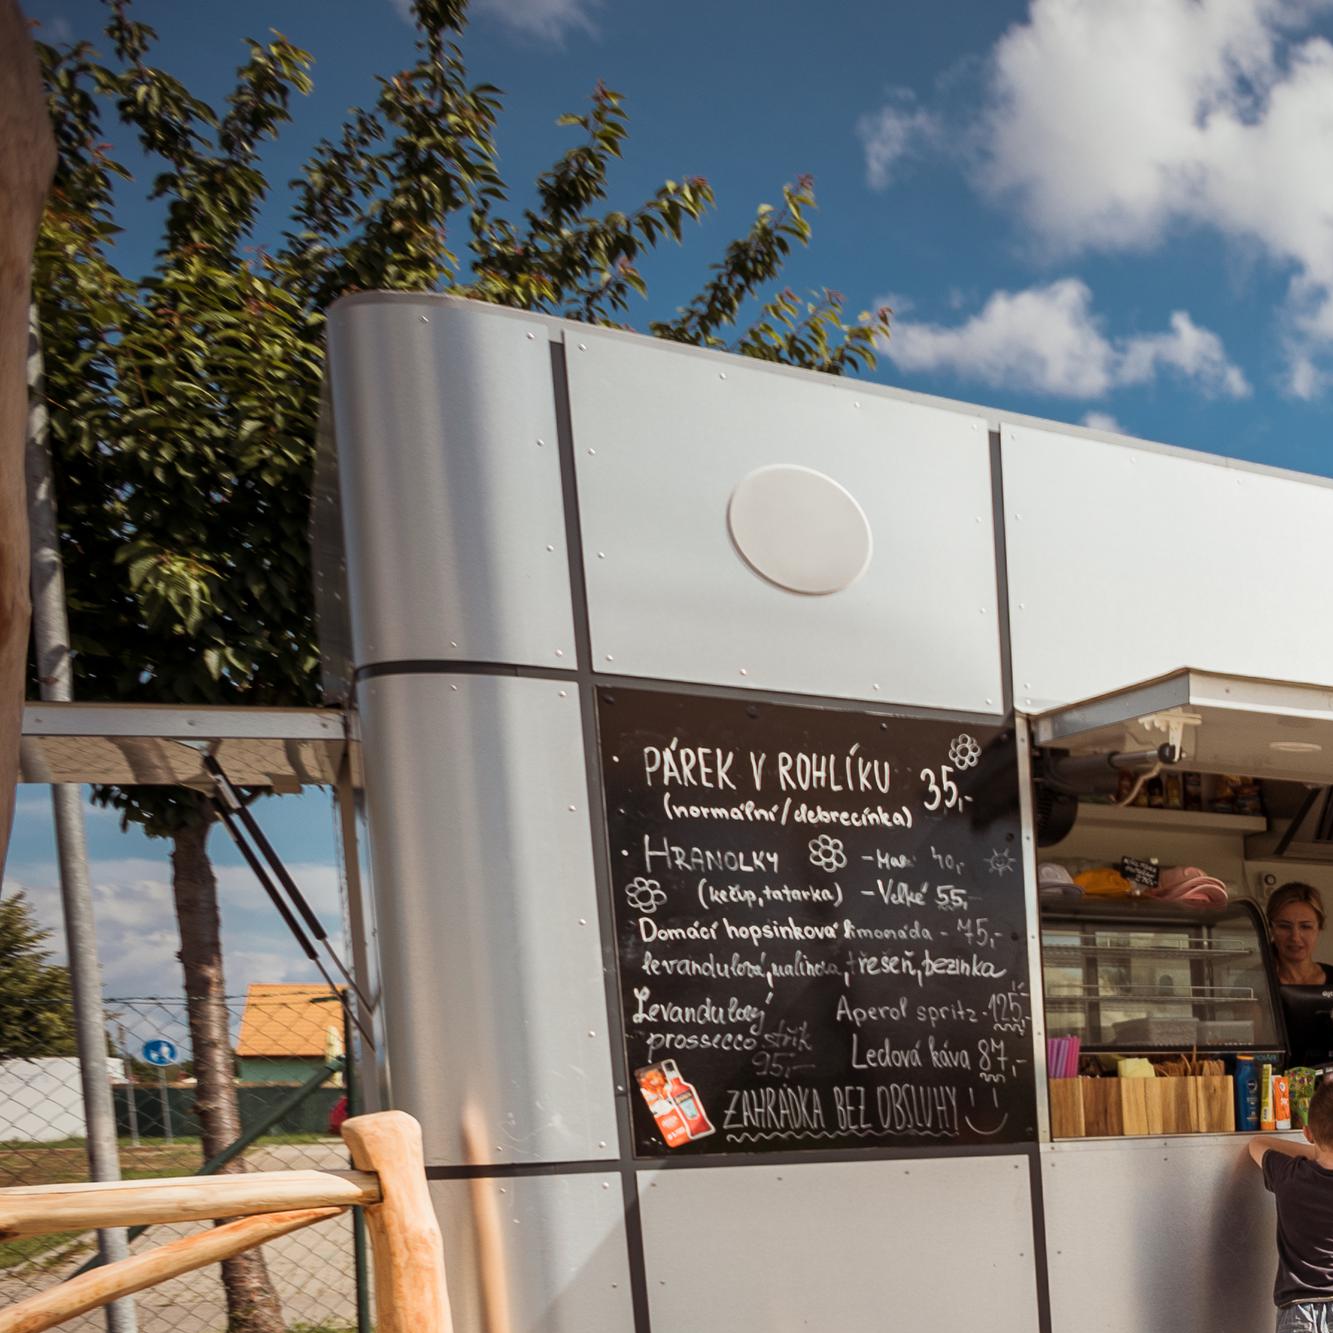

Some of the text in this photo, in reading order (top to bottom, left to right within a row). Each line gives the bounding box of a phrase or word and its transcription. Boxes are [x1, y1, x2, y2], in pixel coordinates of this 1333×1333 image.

[644, 737, 737, 790] PÁREK
[750, 752, 767, 792] V
[779, 742, 890, 794] ROHLÍKU
[644, 834, 780, 873] HRANOLKY
[639, 917, 718, 942] Domácí
[843, 918, 933, 943] limonáda
[837, 995, 907, 1025] Aperol
[917, 997, 978, 1027] spritz
[852, 1034, 921, 1070] Ledová
[929, 1036, 971, 1070] káva
[722, 1084, 959, 1133] ZAHRÁDKA BEZ OBSLUHY
